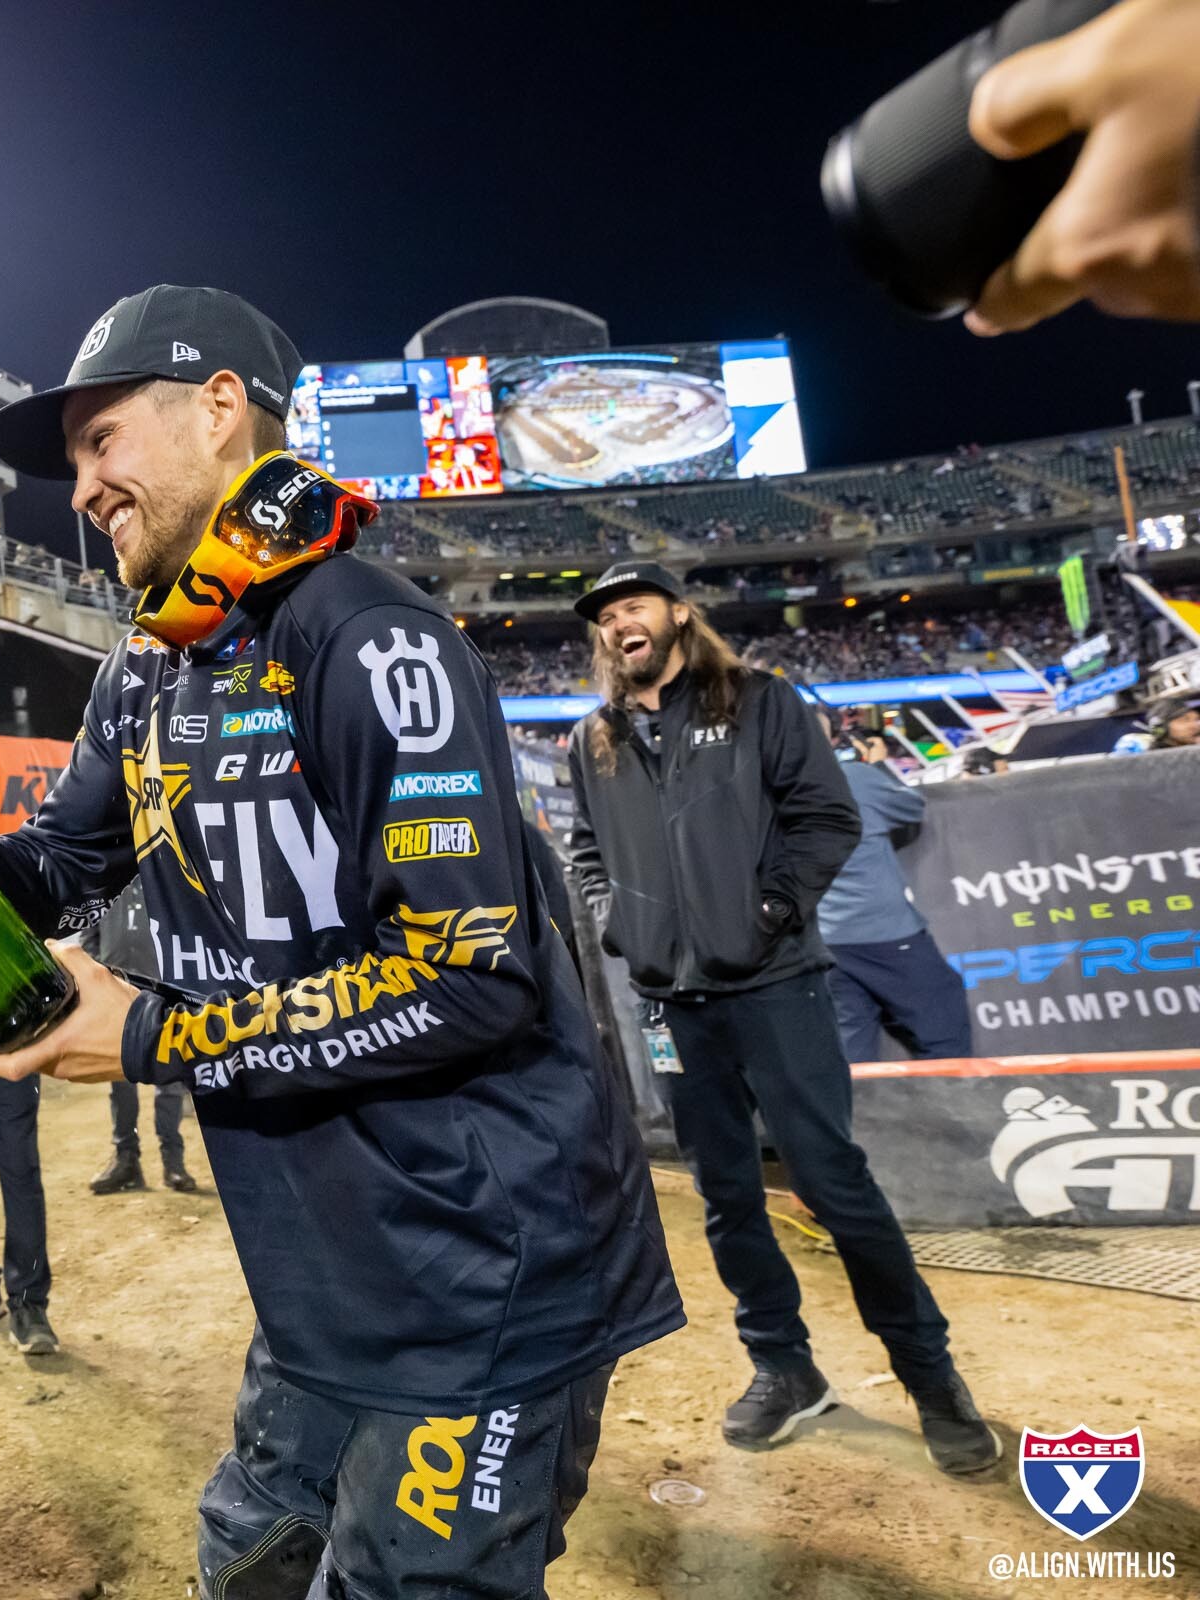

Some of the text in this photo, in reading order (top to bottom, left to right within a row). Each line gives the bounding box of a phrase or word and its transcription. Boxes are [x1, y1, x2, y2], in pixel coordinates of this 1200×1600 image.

[694, 725, 727, 745] FLY
[394, 774, 479, 797] MOTOREX
[1011, 895, 1194, 928] ENERG
[947, 930, 1200, 990] PERC
[194, 1001, 445, 1089] ENERGY DRINK
[471, 1403, 521, 1514] ENER
